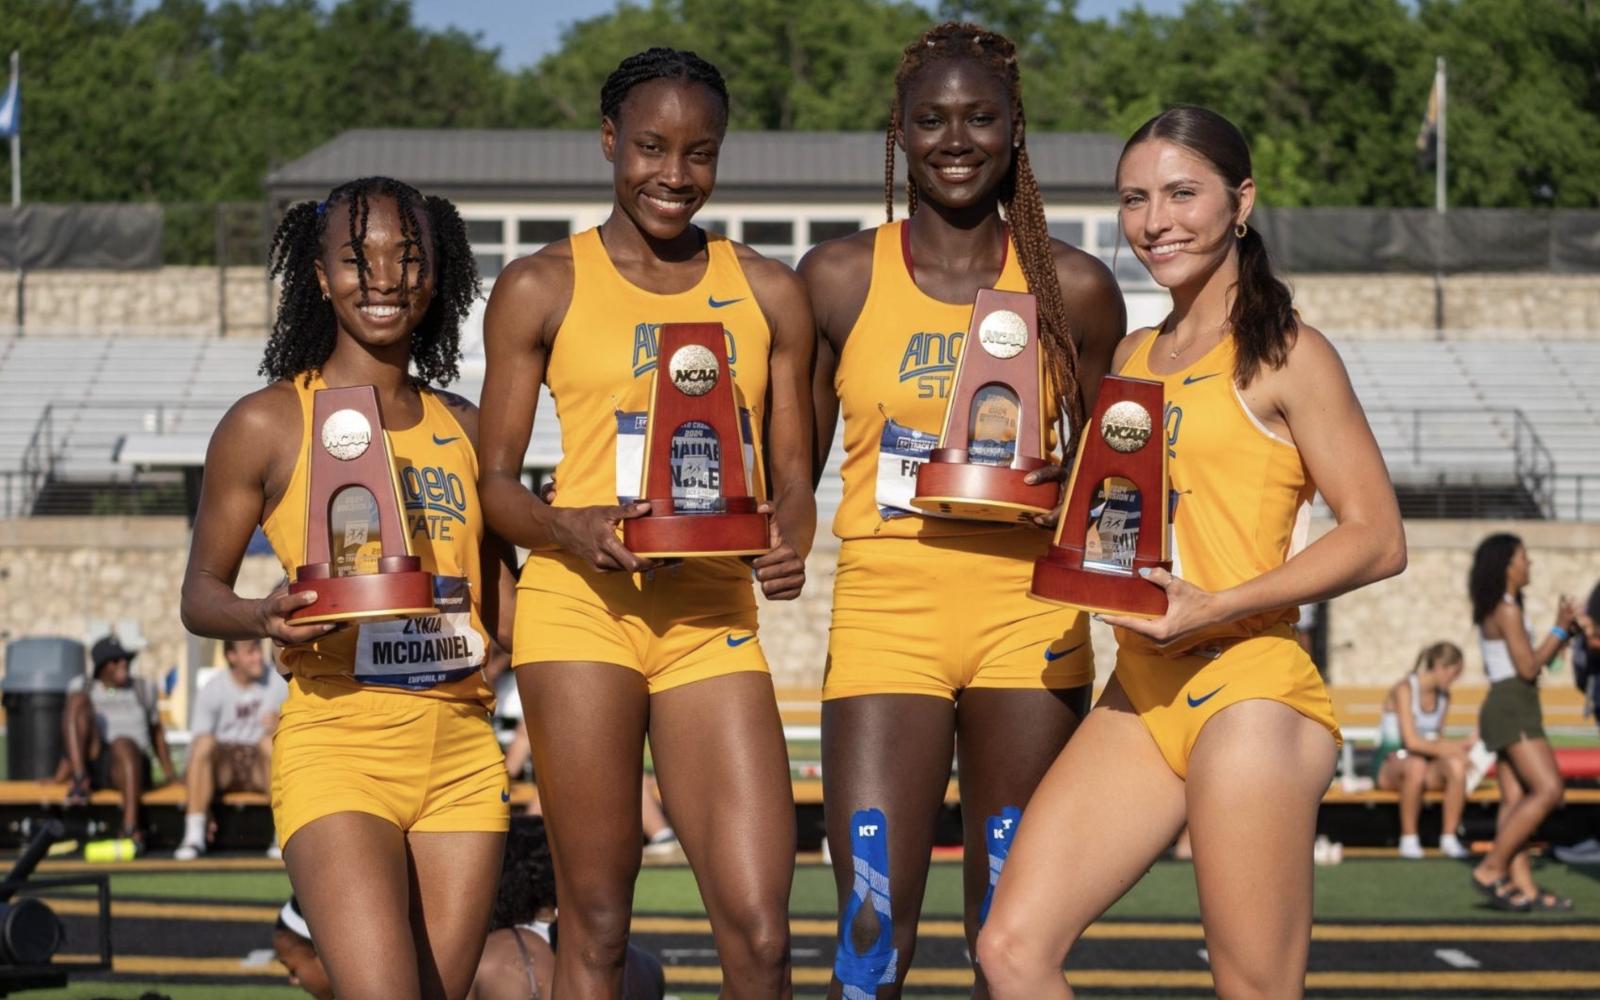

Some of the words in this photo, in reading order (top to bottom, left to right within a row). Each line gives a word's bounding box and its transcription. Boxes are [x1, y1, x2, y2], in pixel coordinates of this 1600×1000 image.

[674, 369, 717, 383] NCAA
[1104, 424, 1150, 441] NCAA
[406, 514, 452, 541] TATE
[402, 615, 442, 635] ZYKIA
[372, 635, 473, 665] MCDANIEL
[858, 825, 879, 837] KT
